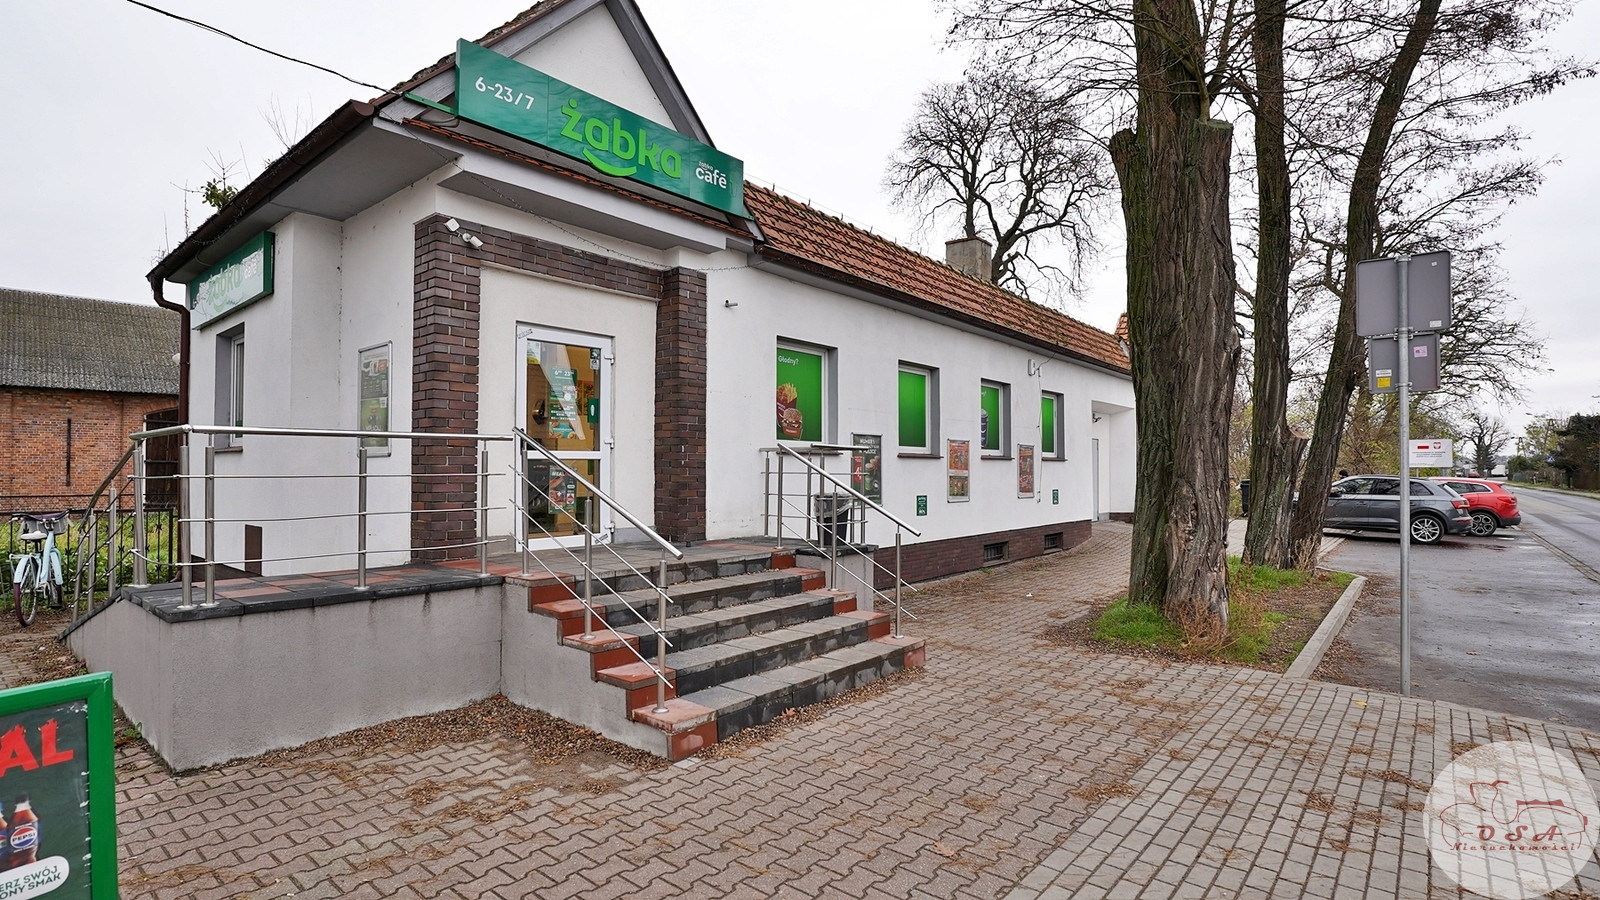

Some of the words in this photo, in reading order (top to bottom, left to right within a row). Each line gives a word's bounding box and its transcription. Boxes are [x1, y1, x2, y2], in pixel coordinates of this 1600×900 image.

[474, 76, 535, 111] 6-23/7
[560, 98, 682, 179] żabka
[12, 832, 36, 842] PEPSI
[23, 865, 58, 884] SWÓJ
[28, 872, 61, 890] SMAK
